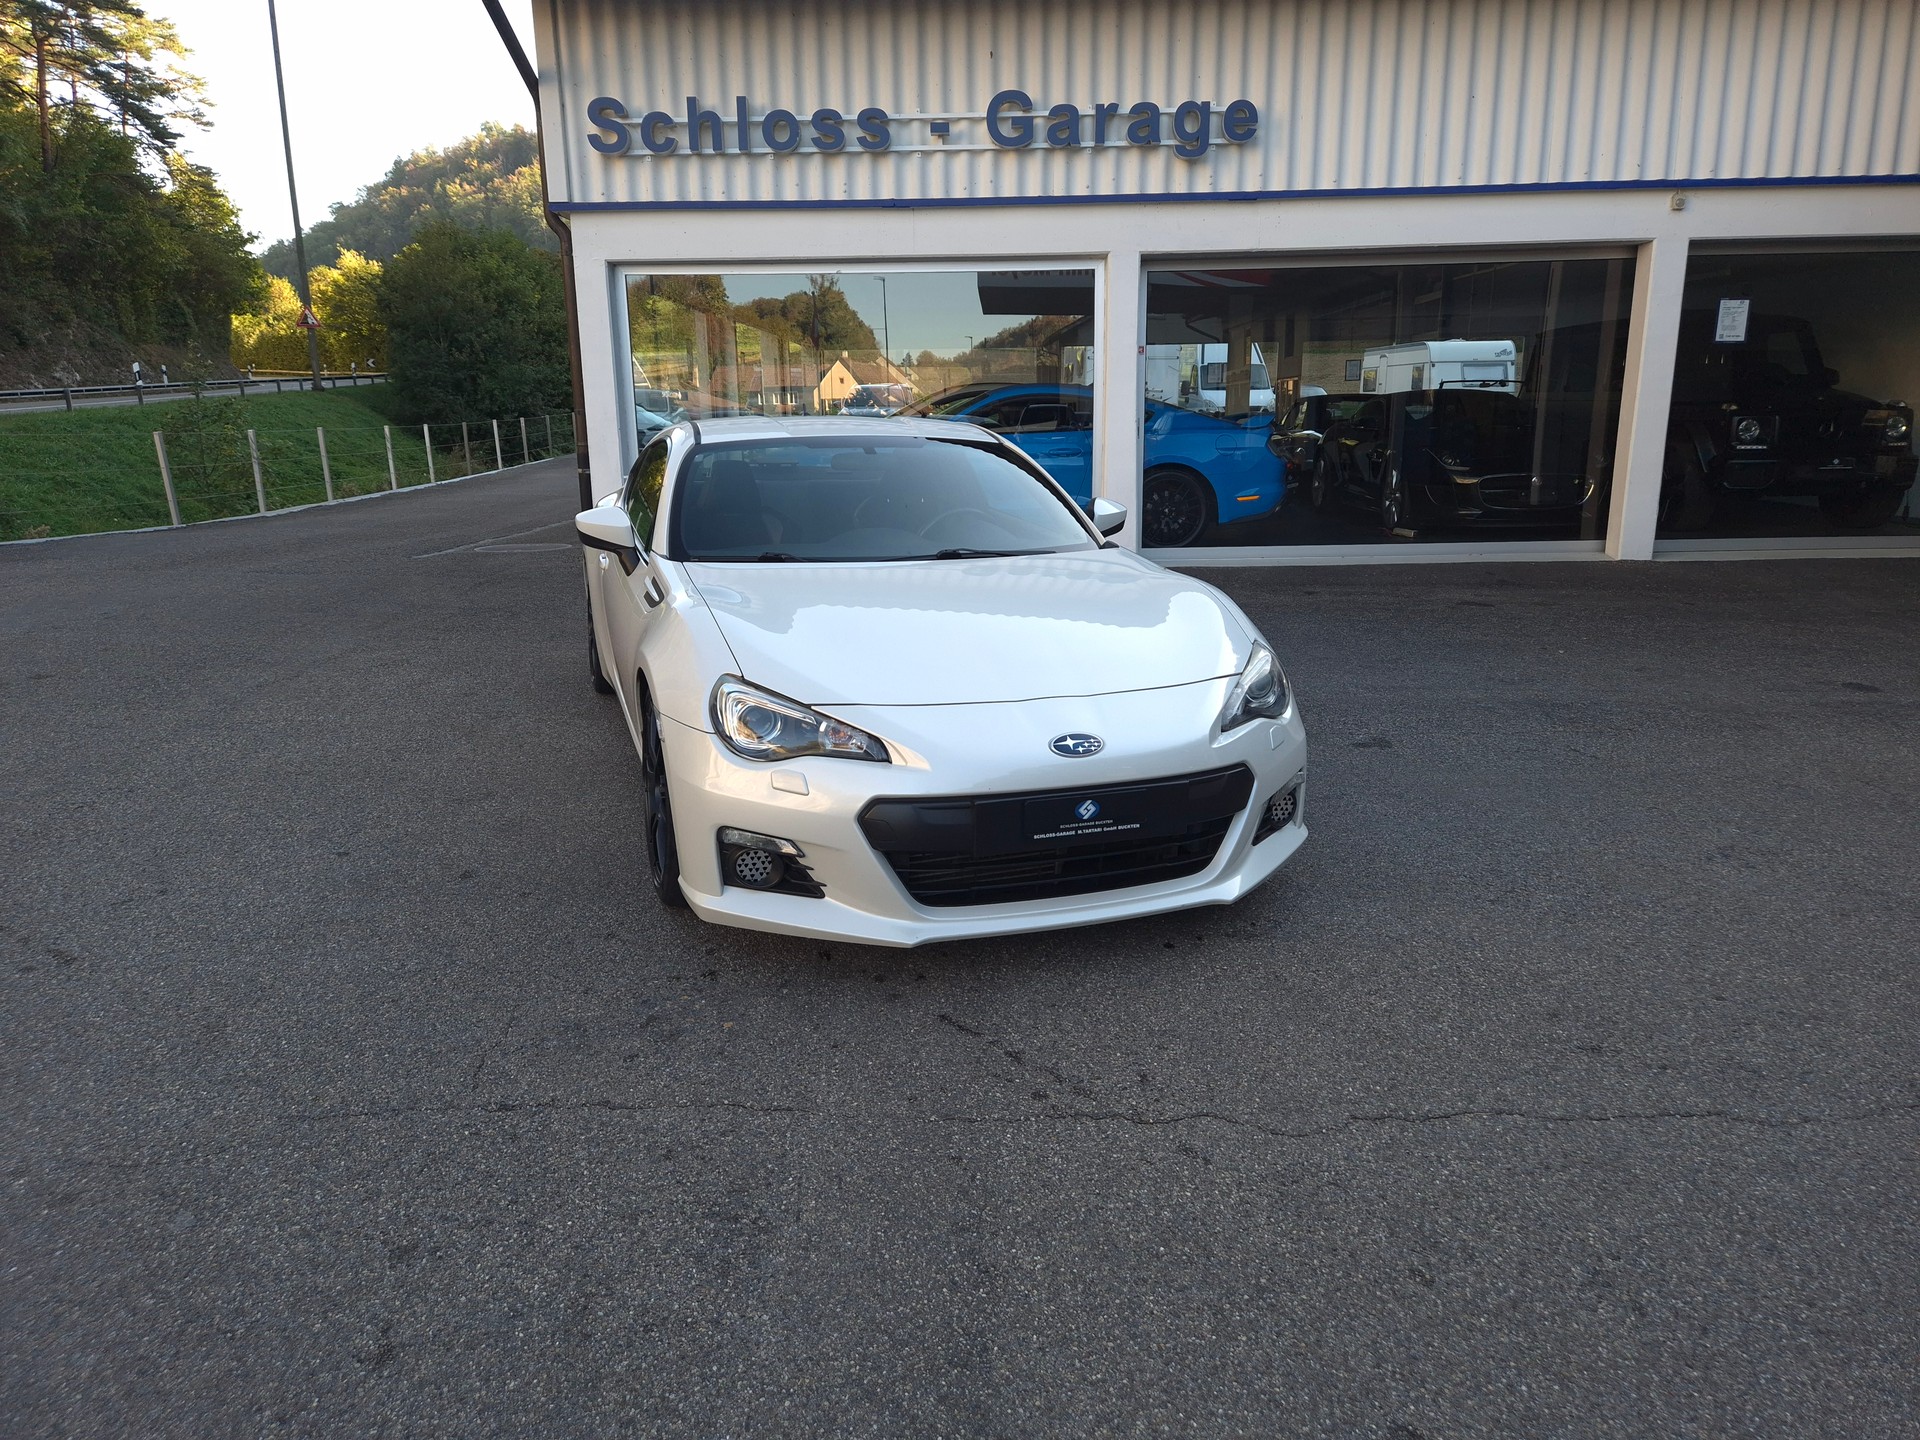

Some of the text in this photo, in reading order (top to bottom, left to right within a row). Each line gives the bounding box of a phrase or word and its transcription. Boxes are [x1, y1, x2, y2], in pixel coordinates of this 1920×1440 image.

[587, 89, 1258, 159] Schloss - Garage
[1033, 830, 1076, 839] SCHLOSS-GARAGE
